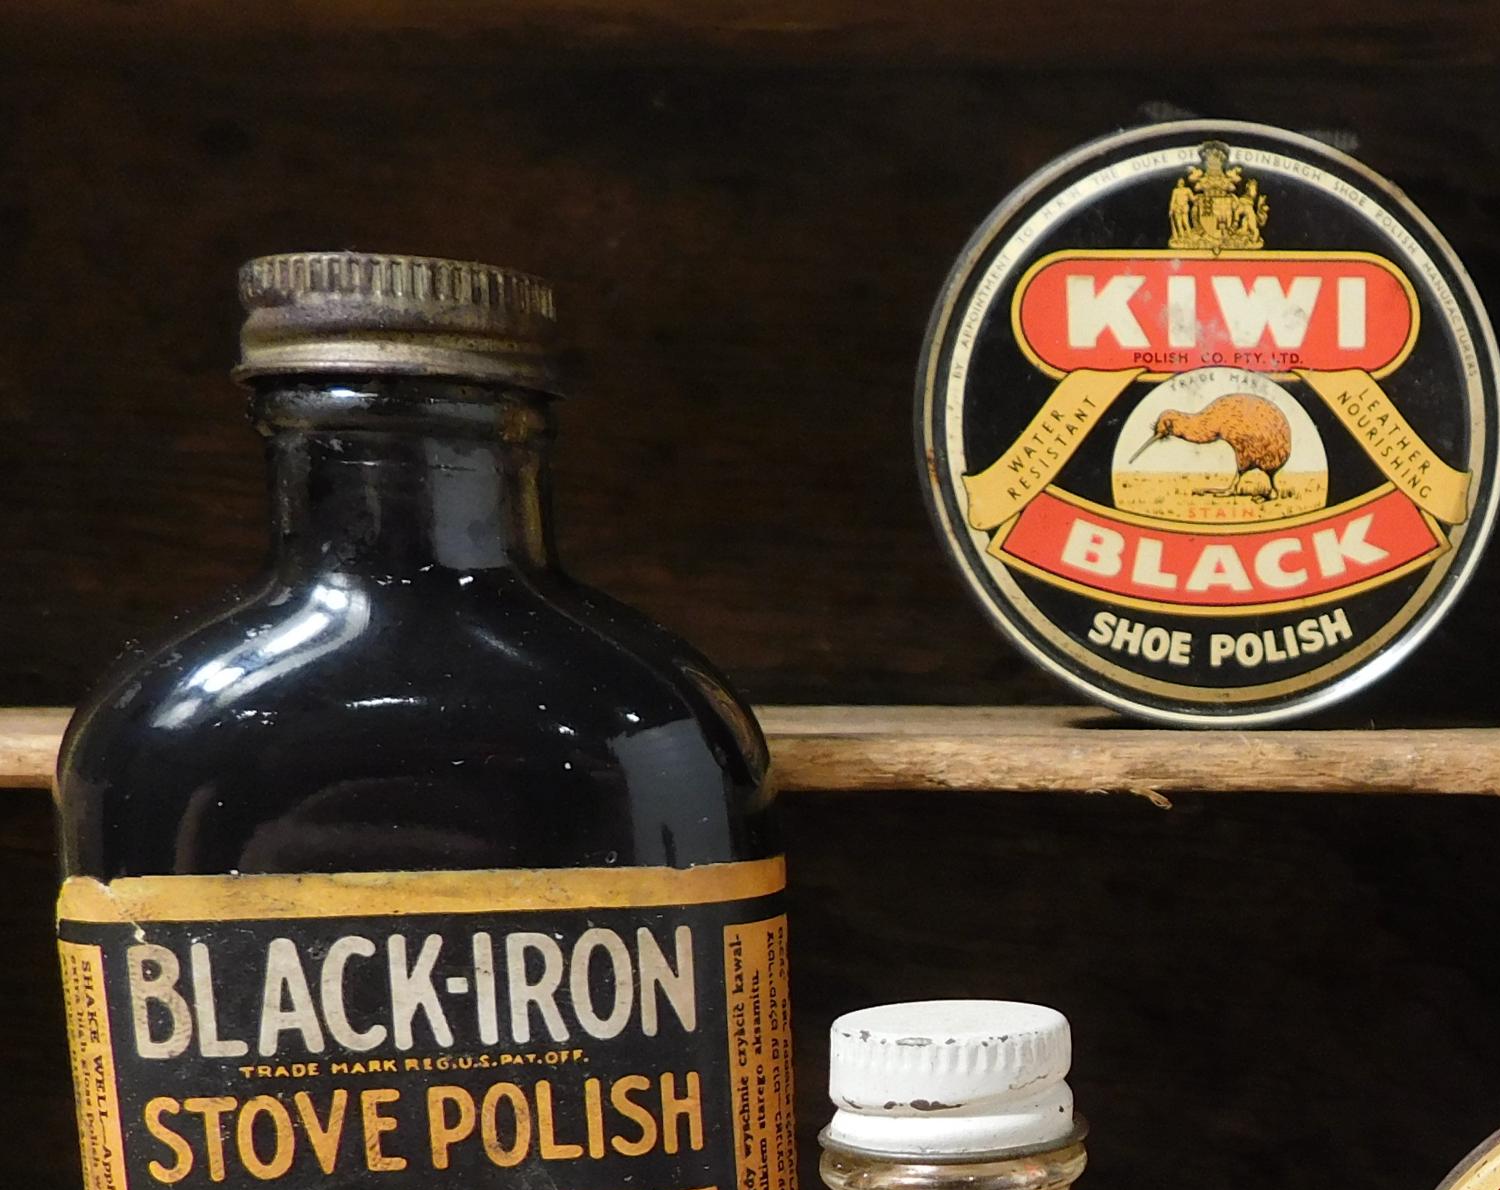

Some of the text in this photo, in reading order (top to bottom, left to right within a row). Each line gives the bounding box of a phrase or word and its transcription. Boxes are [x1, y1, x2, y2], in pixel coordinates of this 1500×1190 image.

[961, 253, 1012, 348] APPOINTMENT
[1132, 154, 1168, 171] DUKE
[1235, 151, 1322, 180] EDINBURGH
[1333, 181, 1366, 207] SHOE
[1375, 210, 1419, 254] POLISH
[1423, 262, 1478, 378] MANUFACTURERS
[1065, 274, 1366, 348] KIWI
[1134, 351, 1303, 364] POLISH CO. PTY. LTD.
[1170, 371, 1216, 390] TRADE
[1007, 409, 1064, 473] WATER
[1007, 395, 1097, 501] RESISTANT
[1337, 391, 1432, 499] NOURISHING
[1358, 387, 1431, 475] LEATHER
[1186, 506, 1255, 518] STAIN
[1060, 513, 1390, 592] BLACK
[1087, 607, 1352, 667] SHOE POLISH
[80, 958, 99, 1044] SHAKE
[126, 925, 697, 1059] BLACK-IRON
[239, 1063, 318, 1079] TRADE
[331, 1060, 397, 1075] MARK
[754, 1064, 766, 1130] starego
[145, 1089, 407, 1184] STOVE
[427, 1071, 703, 1170] POLISH
[739, 1076, 753, 1160] wyschnie
